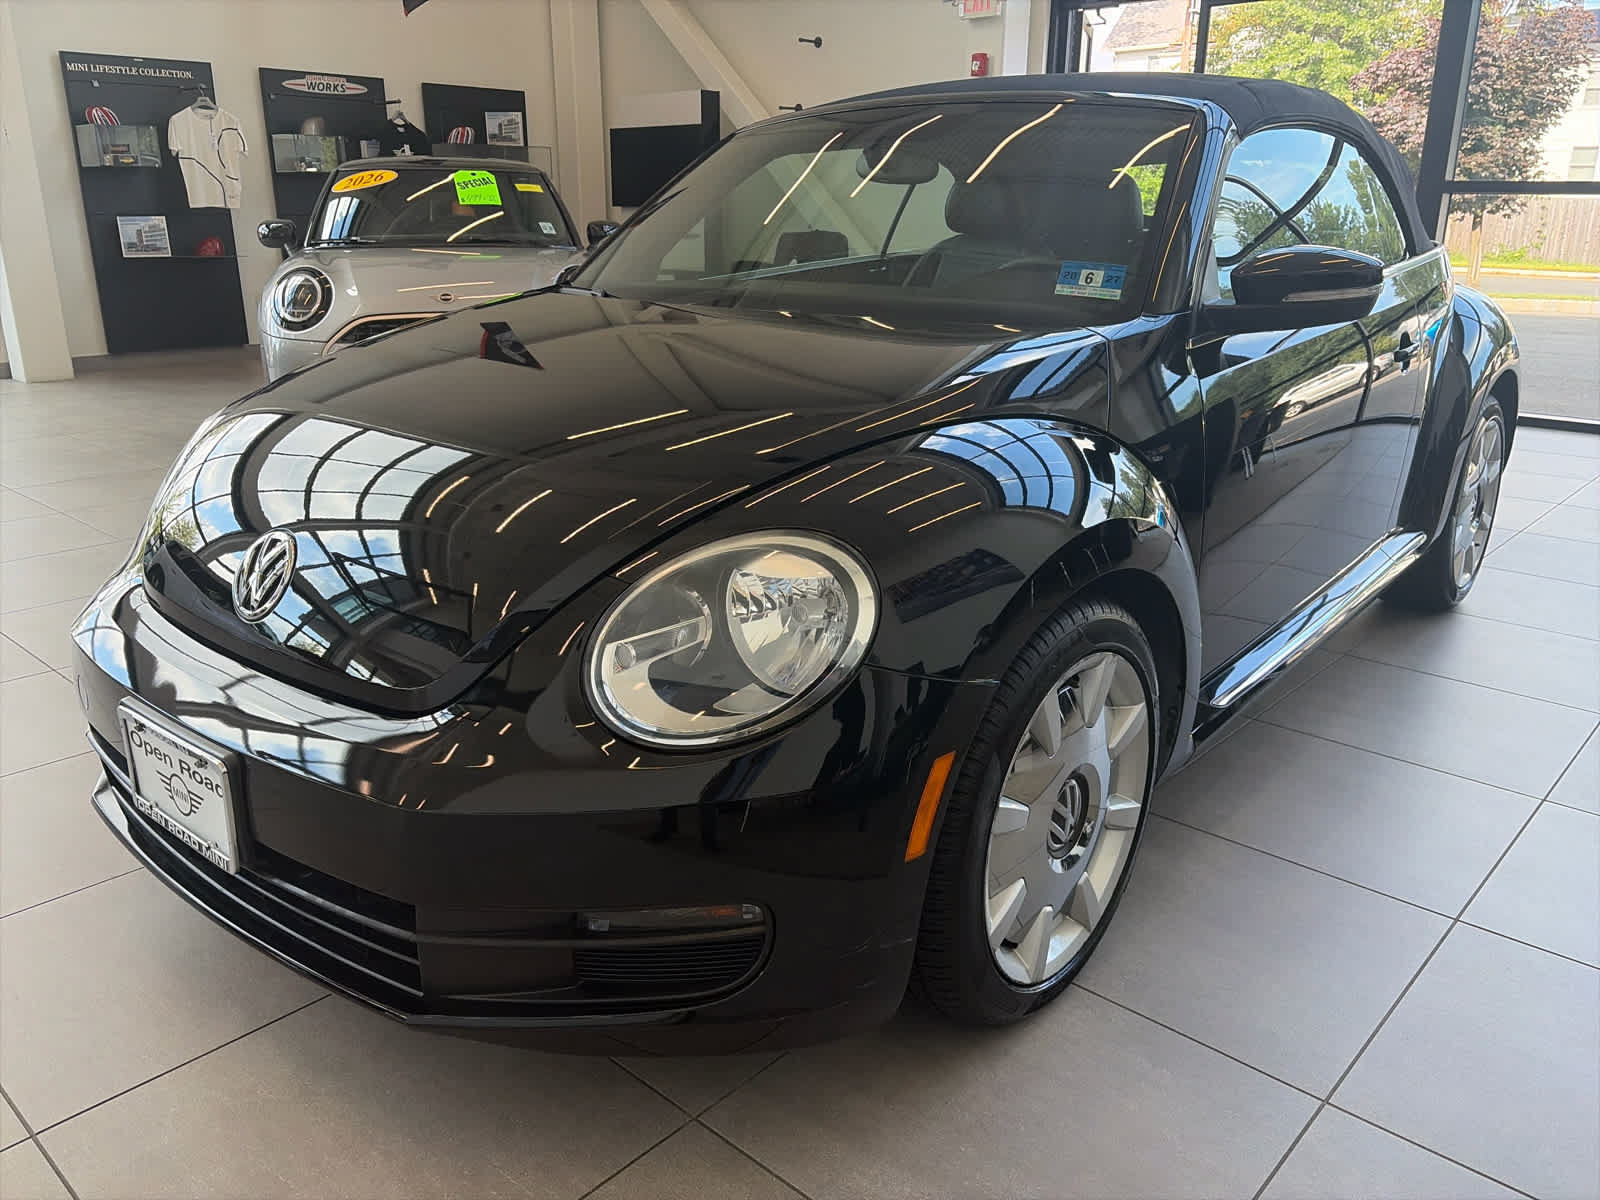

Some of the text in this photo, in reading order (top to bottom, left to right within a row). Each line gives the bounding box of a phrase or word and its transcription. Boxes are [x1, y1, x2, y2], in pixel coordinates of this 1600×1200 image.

[66, 62, 88, 72] MINI
[90, 64, 138, 75] LIFESTYLE
[306, 81, 346, 92] WORKS
[344, 172, 386, 189] 2026
[457, 176, 495, 190] SPECIAL
[1084, 271, 1095, 285] 6
[130, 730, 173, 769] Open
[169, 821, 198, 850] ROAD
[202, 846, 228, 870] MINI
